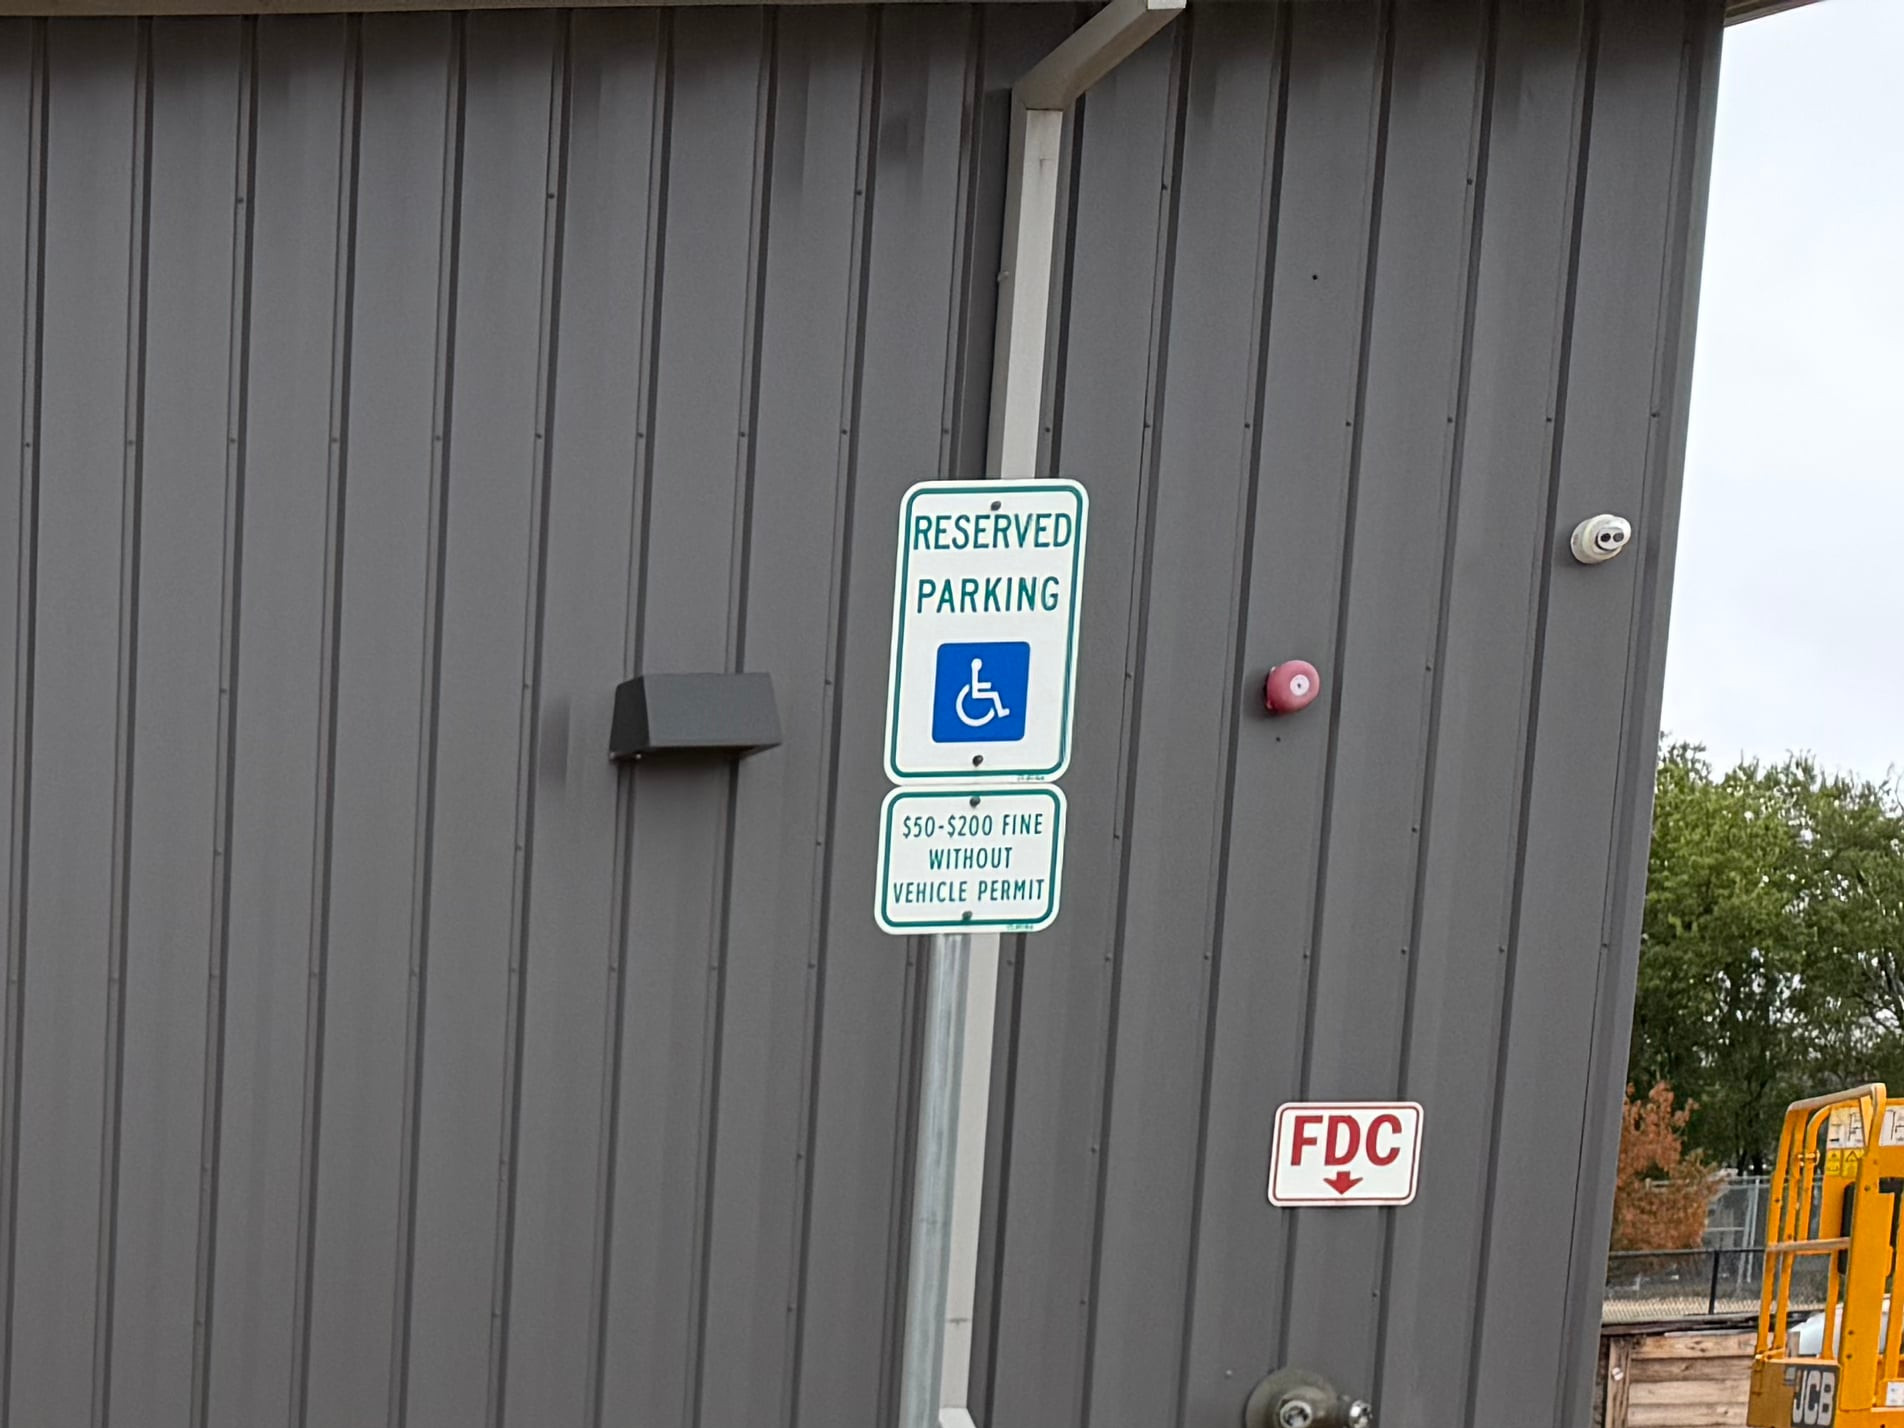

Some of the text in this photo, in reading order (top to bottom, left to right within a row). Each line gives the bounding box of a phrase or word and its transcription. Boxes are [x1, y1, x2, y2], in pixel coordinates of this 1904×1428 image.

[913, 513, 1073, 550] RESERVED
[916, 576, 1060, 614] PARKING
[902, 813, 1043, 840] $50-$200 FINE
[928, 847, 1013, 870] WITHOUT
[893, 879, 1045, 904] VEHICLE PERMIT
[1291, 1114, 1403, 1166] FDC
[1793, 1369, 1836, 1426] JCB
